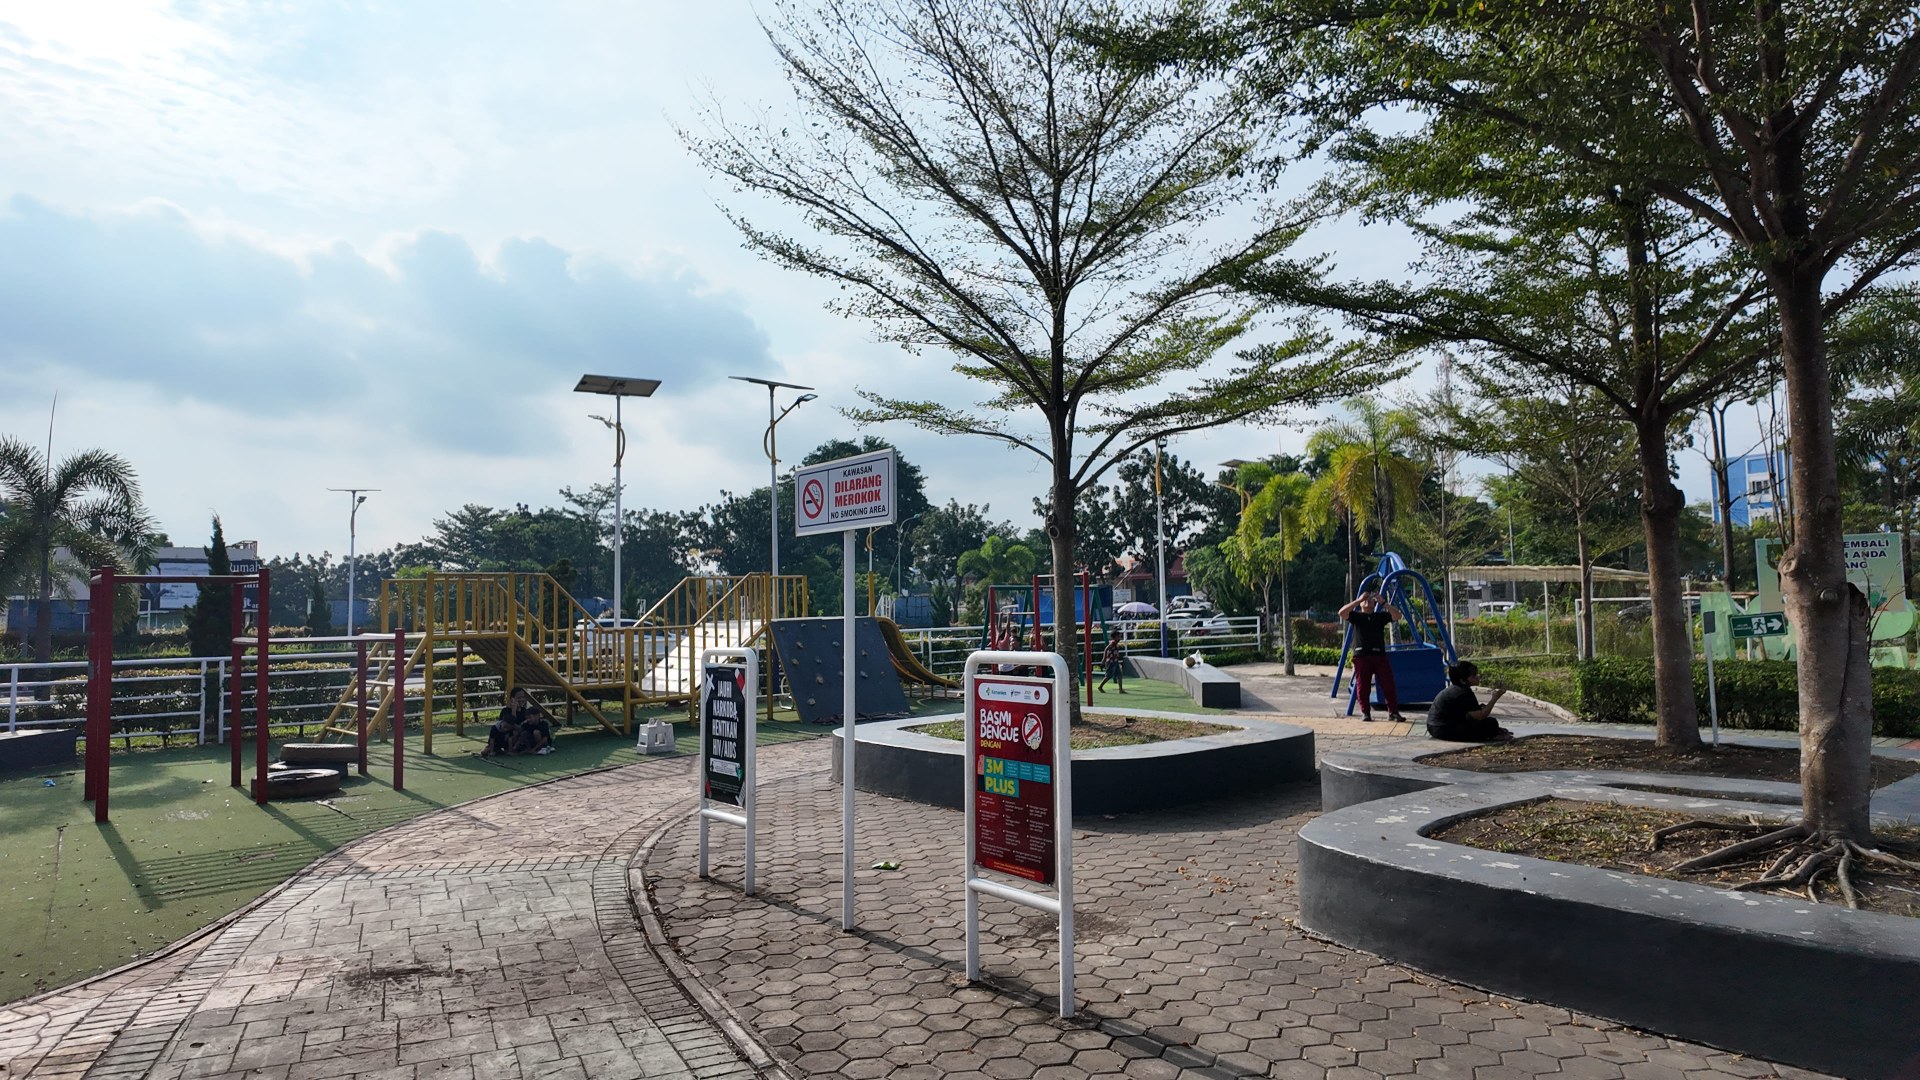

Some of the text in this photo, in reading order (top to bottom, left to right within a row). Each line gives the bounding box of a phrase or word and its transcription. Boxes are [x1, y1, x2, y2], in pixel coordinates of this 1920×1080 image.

[842, 465, 873, 478] KAWASAN
[834, 474, 882, 494] DILARANG
[834, 489, 881, 508] MEROKOK
[830, 504, 886, 520] NO SMOKING AREA
[1843, 539, 1889, 549] EMBALI
[717, 680, 732, 698] JAUHI
[980, 708, 1012, 726] BASMI
[711, 719, 738, 739] HENTIKAN
[980, 724, 1019, 743] DENGUE
[712, 738, 737, 759] HIV/AIDS
[980, 740, 1002, 749] DENGAN
[985, 758, 1004, 775] 3M
[985, 776, 1016, 795] PLUS
